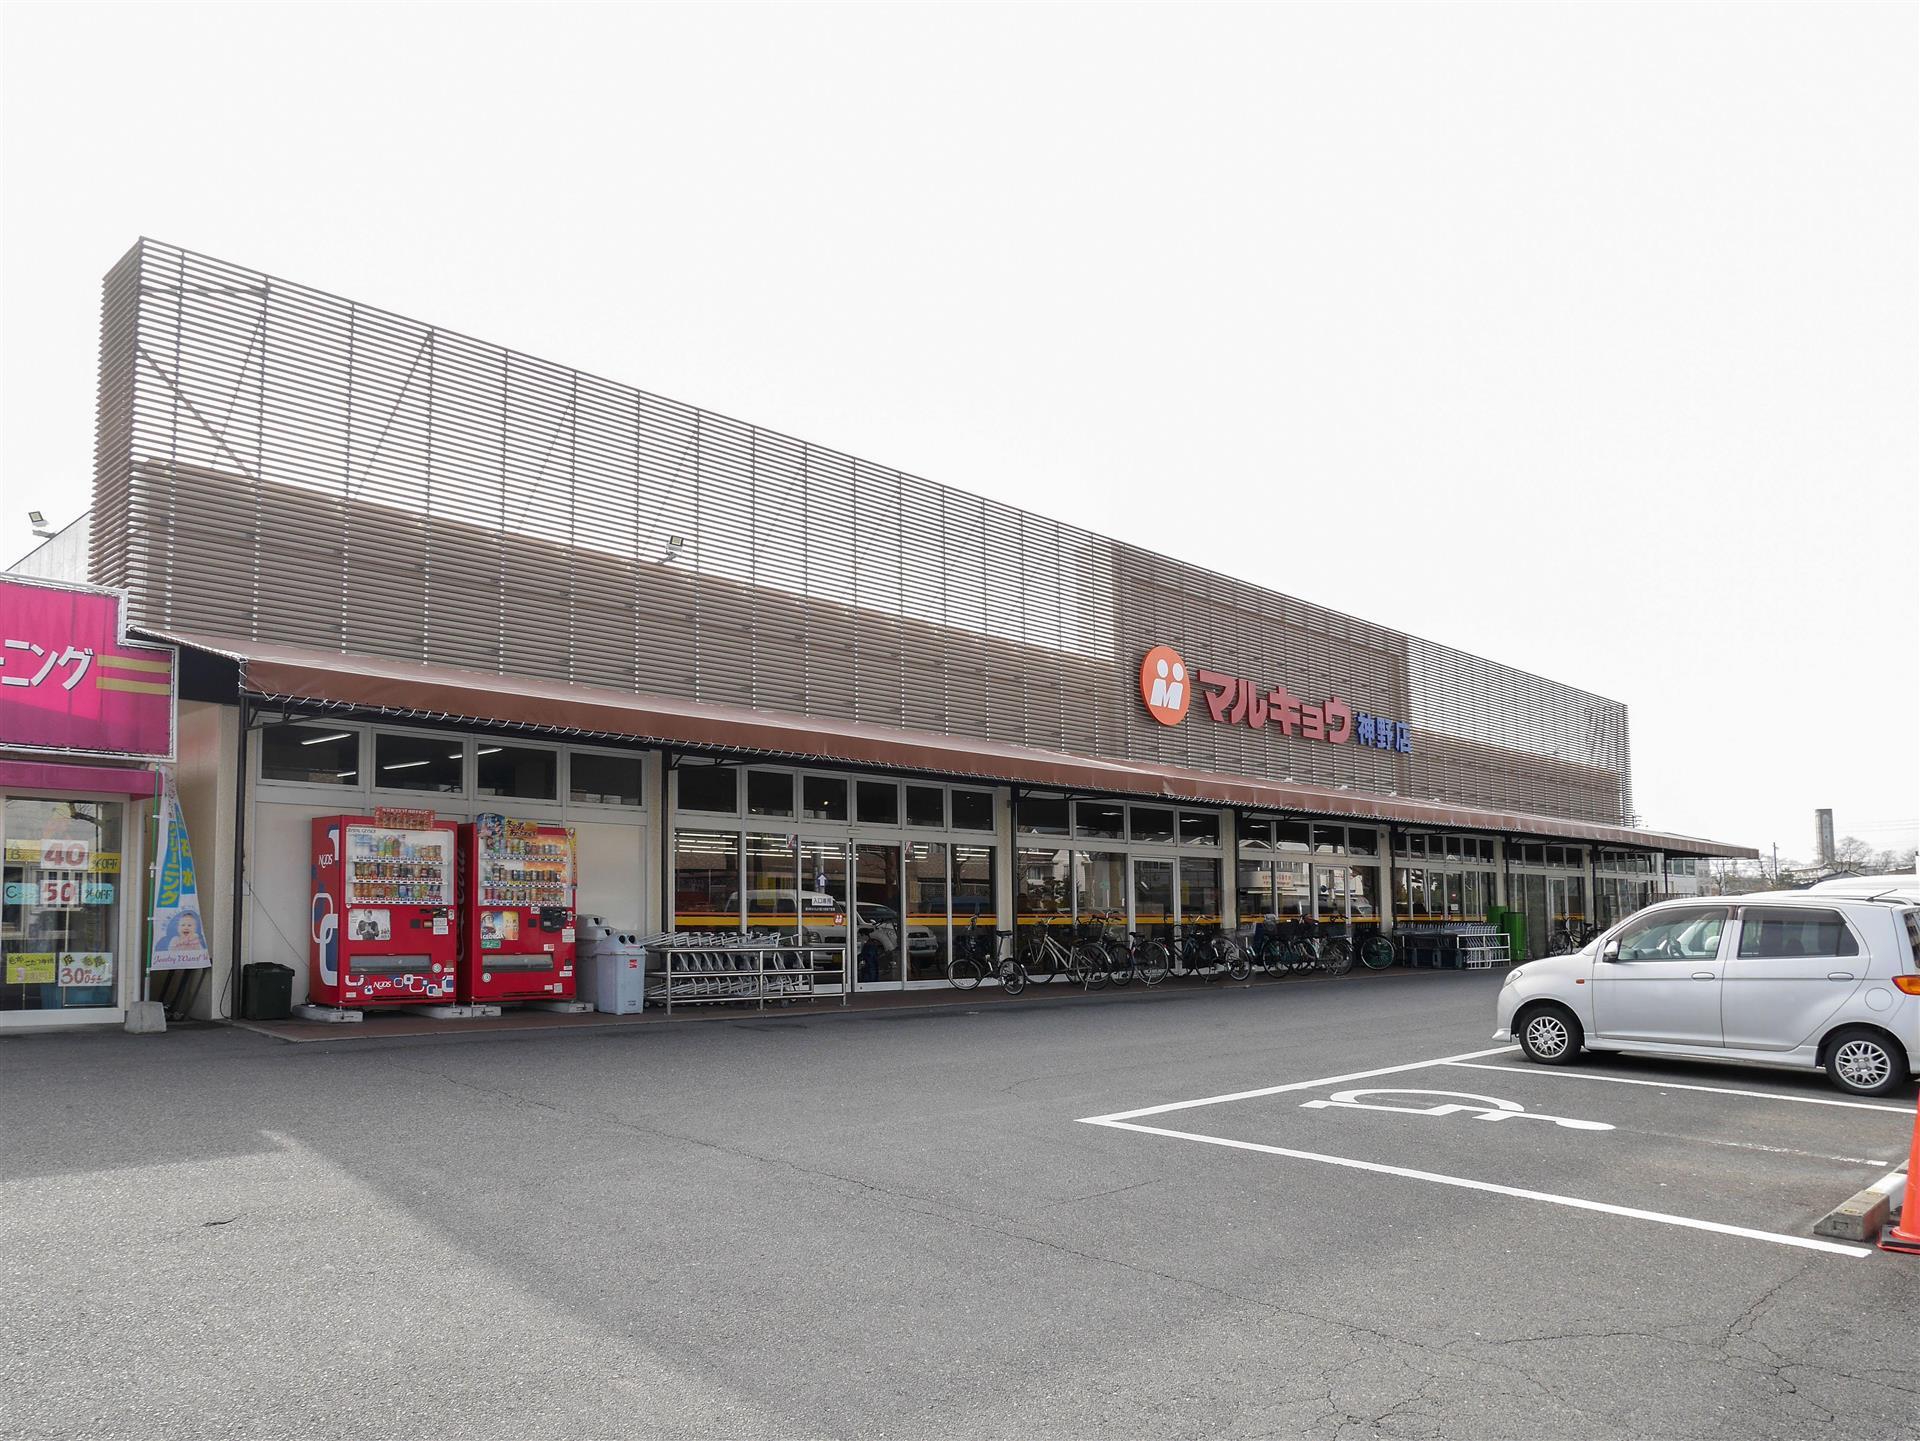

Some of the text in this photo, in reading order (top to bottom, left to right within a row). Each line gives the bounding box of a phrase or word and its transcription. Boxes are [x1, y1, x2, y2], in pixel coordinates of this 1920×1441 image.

[0, 640, 94, 691] ニング
[1197, 670, 1412, 753] マルキョウ 神野店
[44, 843, 86, 866] 40
[44, 883, 76, 902] 50
[60, 967, 84, 984] 30
